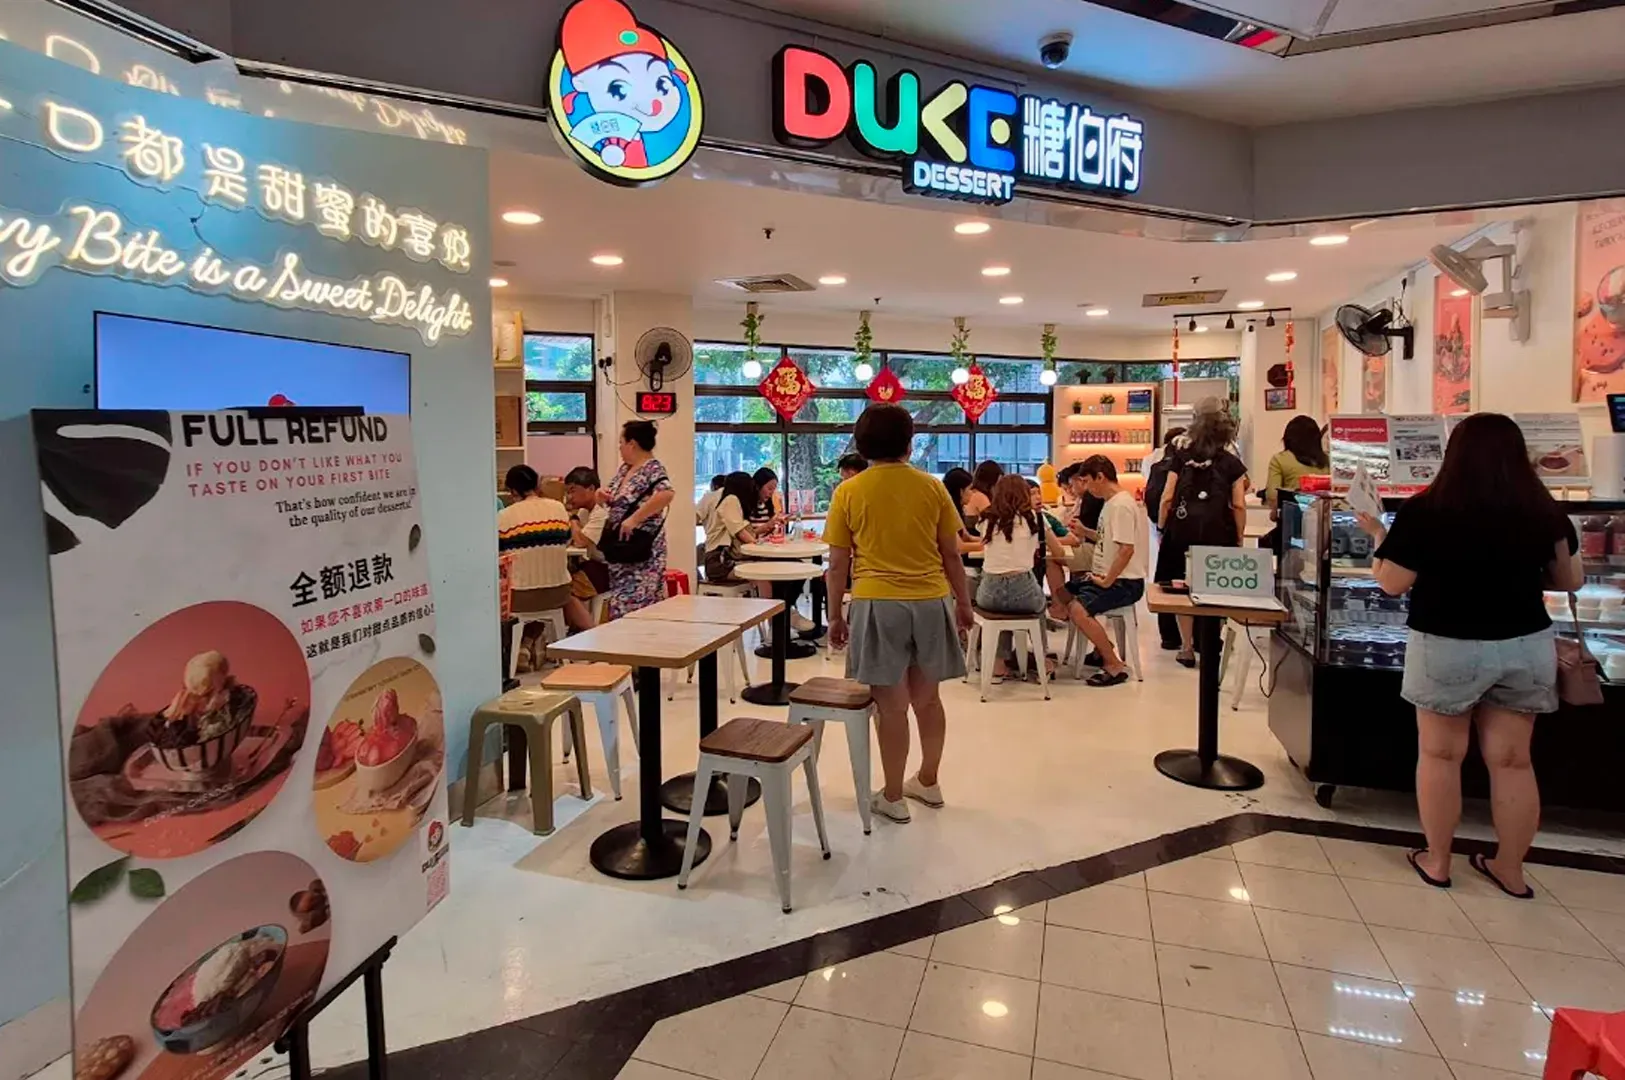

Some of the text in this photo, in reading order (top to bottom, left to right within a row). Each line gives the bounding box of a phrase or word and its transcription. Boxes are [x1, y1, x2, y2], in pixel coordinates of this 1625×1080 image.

[782, 47, 1016, 171] DUKE
[1023, 96, 1143, 191] 糖伯府
[0, 98, 471, 270] 口都是甜蜜的喜悦
[913, 160, 1015, 199] DESSERT
[67, 205, 185, 275] Bite
[190, 247, 230, 285] is
[233, 265, 267, 291] a
[265, 252, 373, 312] Sweet
[369, 275, 473, 342] Delight
[181, 414, 388, 447] FULL REFUND
[186, 452, 403, 477] IF YOU DON'T LIKE WHAT YOU
[188, 468, 391, 498] TASTE ON YOUR FIRST BITE
[275, 497, 312, 514] That's
[313, 496, 336, 509] how
[338, 490, 382, 507] confident
[382, 490, 395, 500] we
[395, 488, 408, 498] are
[288, 514, 309, 528] the
[310, 509, 347, 527] quality
[348, 504, 360, 519] of
[360, 504, 377, 517] our
[1204, 553, 1259, 572] Grab
[288, 552, 395, 608] 全额退款
[1205, 572, 1259, 590] Food
